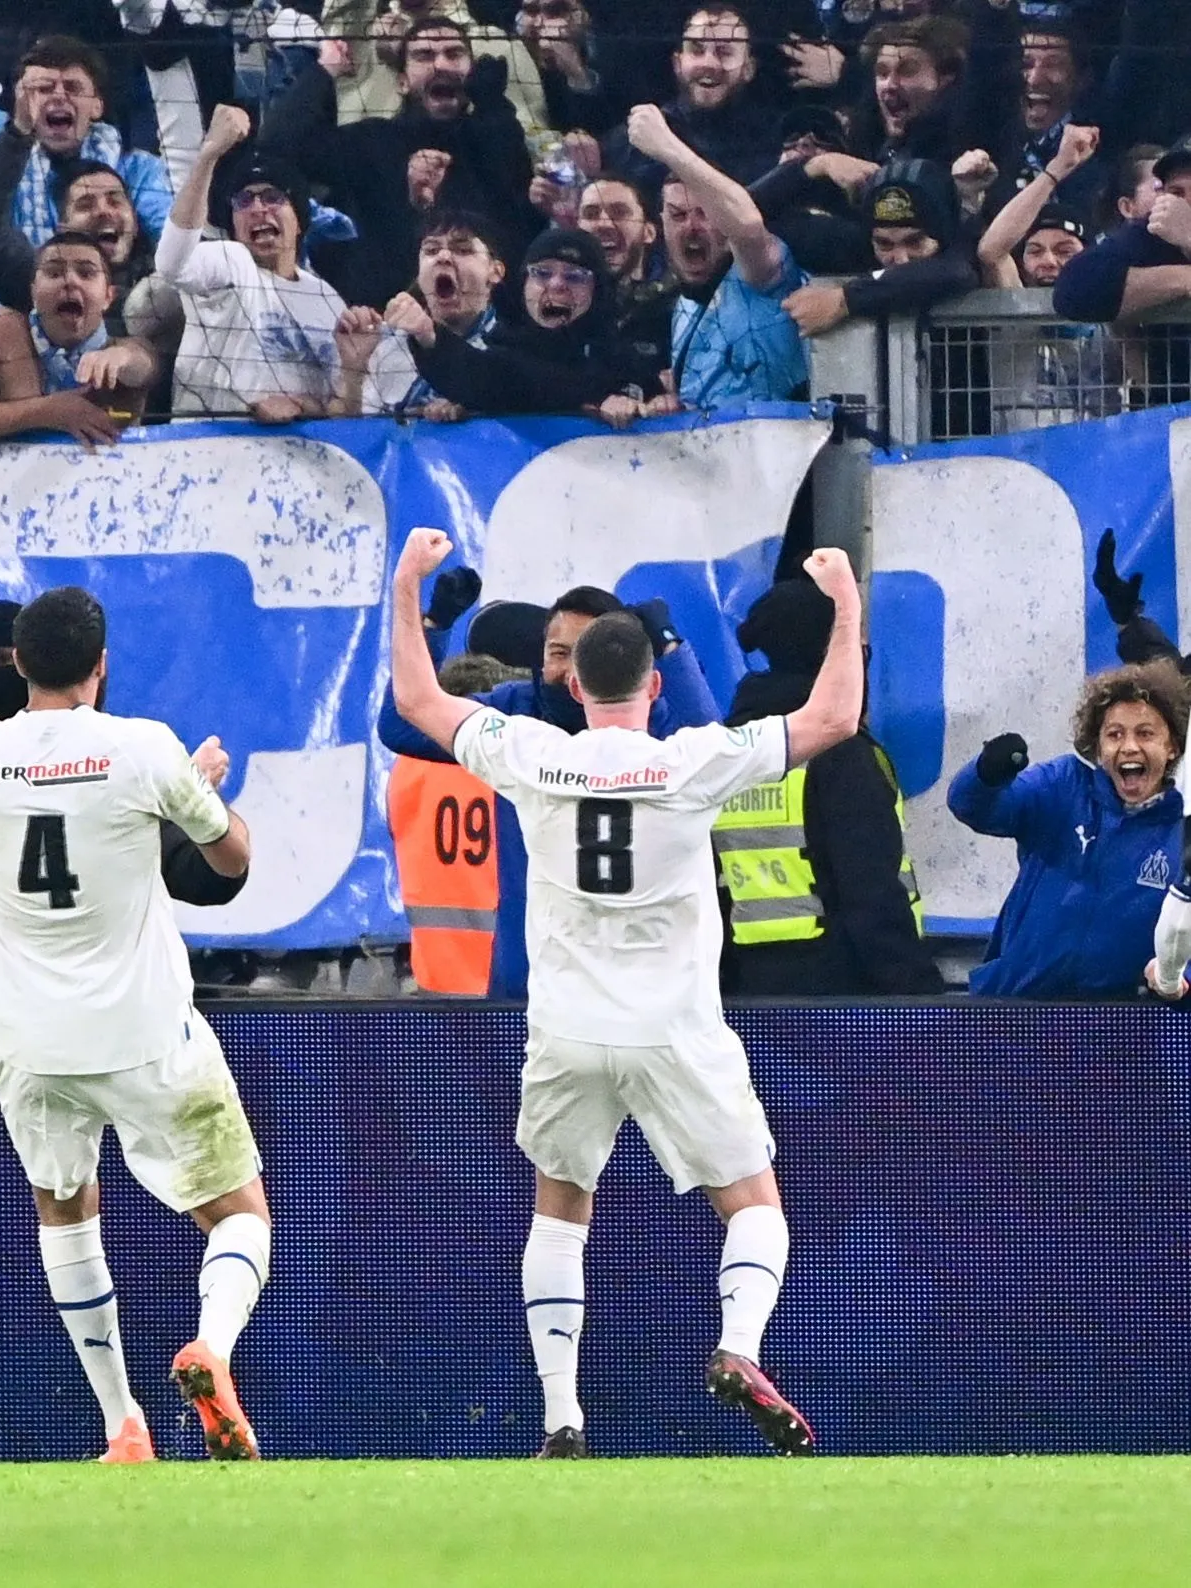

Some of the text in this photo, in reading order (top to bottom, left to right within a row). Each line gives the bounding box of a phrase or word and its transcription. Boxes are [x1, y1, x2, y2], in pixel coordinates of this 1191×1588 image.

[18, 815, 80, 909] 4
[435, 796, 491, 865] 09
[576, 798, 633, 894] 8
